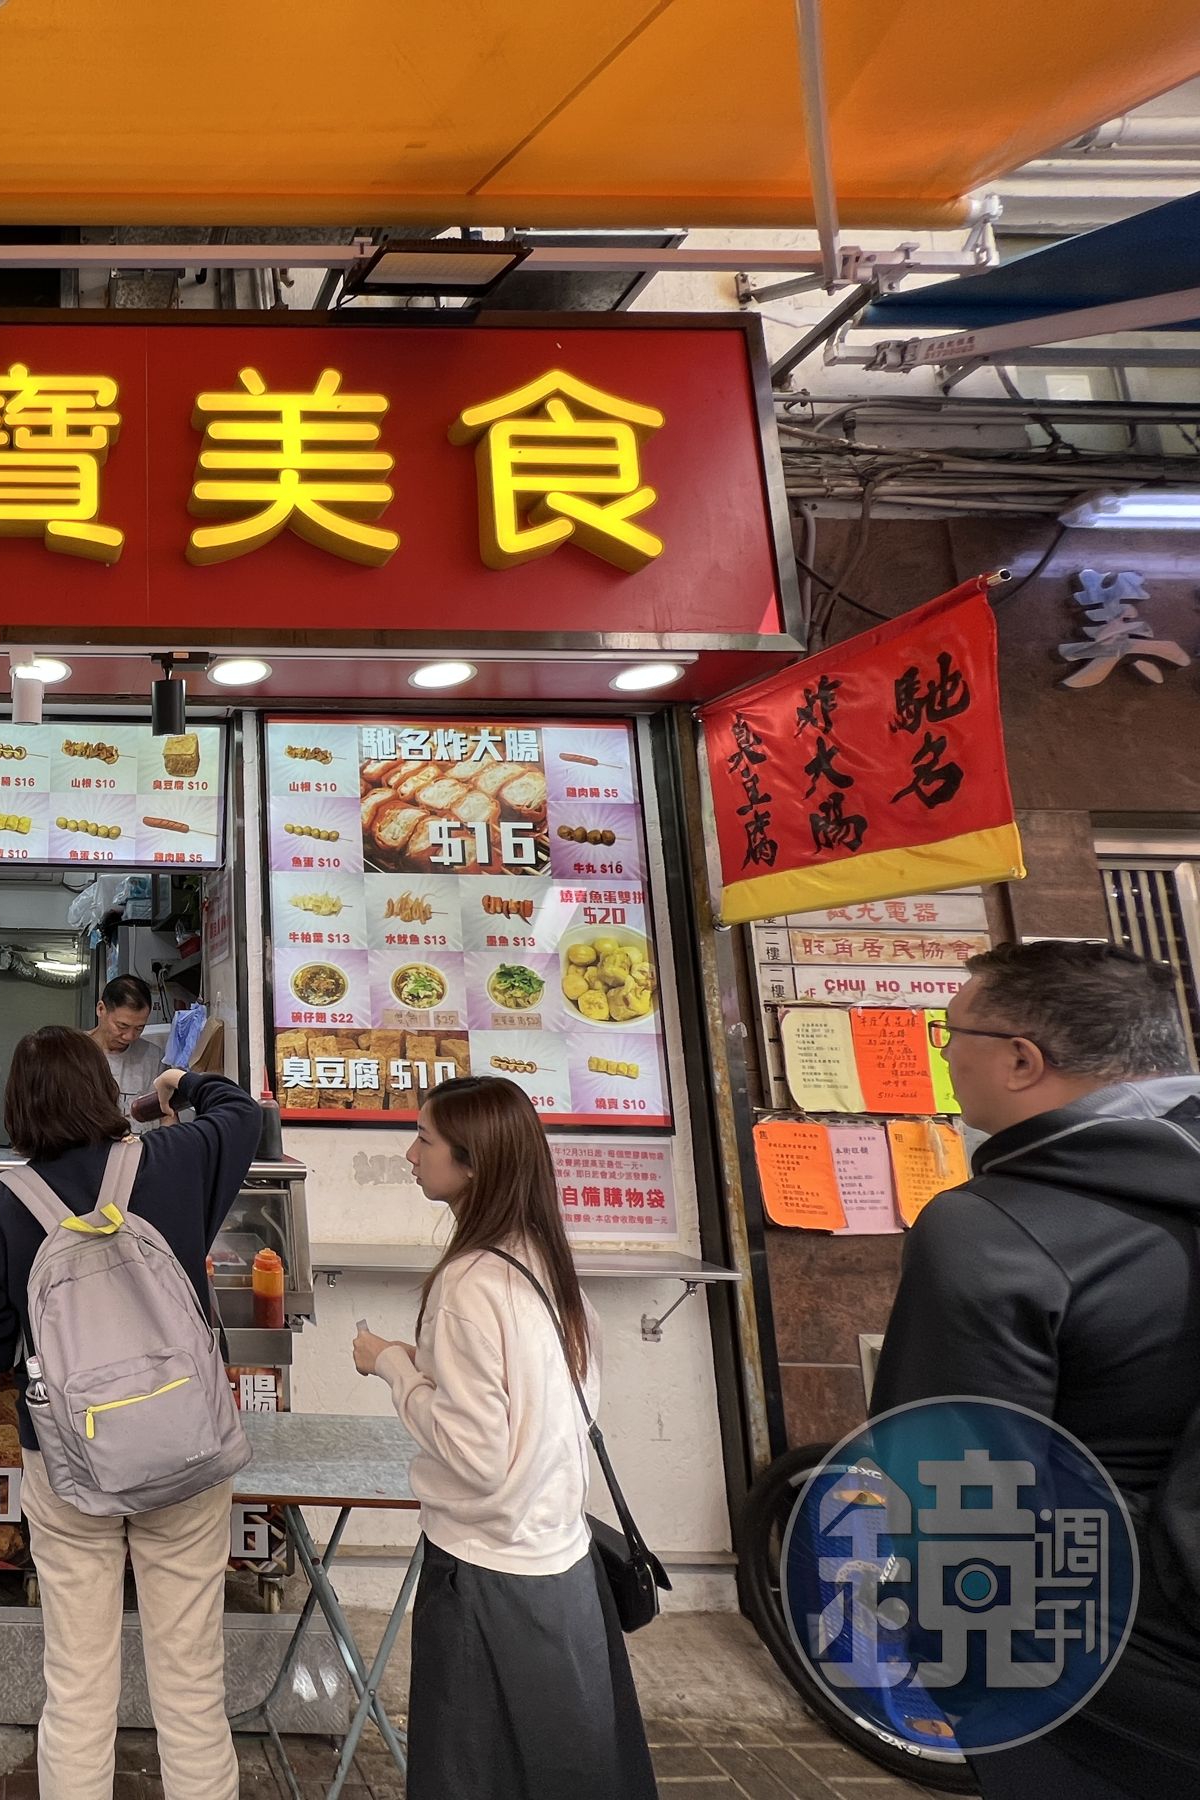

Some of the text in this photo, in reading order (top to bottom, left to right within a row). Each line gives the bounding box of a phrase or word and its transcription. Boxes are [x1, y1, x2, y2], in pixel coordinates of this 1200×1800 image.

[889, 652, 971, 810] 馳名
[362, 728, 540, 763] 馳名炸大腸
[429, 820, 536, 866] $16
[584, 907, 626, 925] $20
[803, 937, 975, 960] 旺角居民協會
[825, 979, 866, 993] CHUI
[876, 980, 900, 993] HO
[282, 1057, 379, 1089] 臭豆腐
[562, 1186, 665, 1208] 自備購物袋
